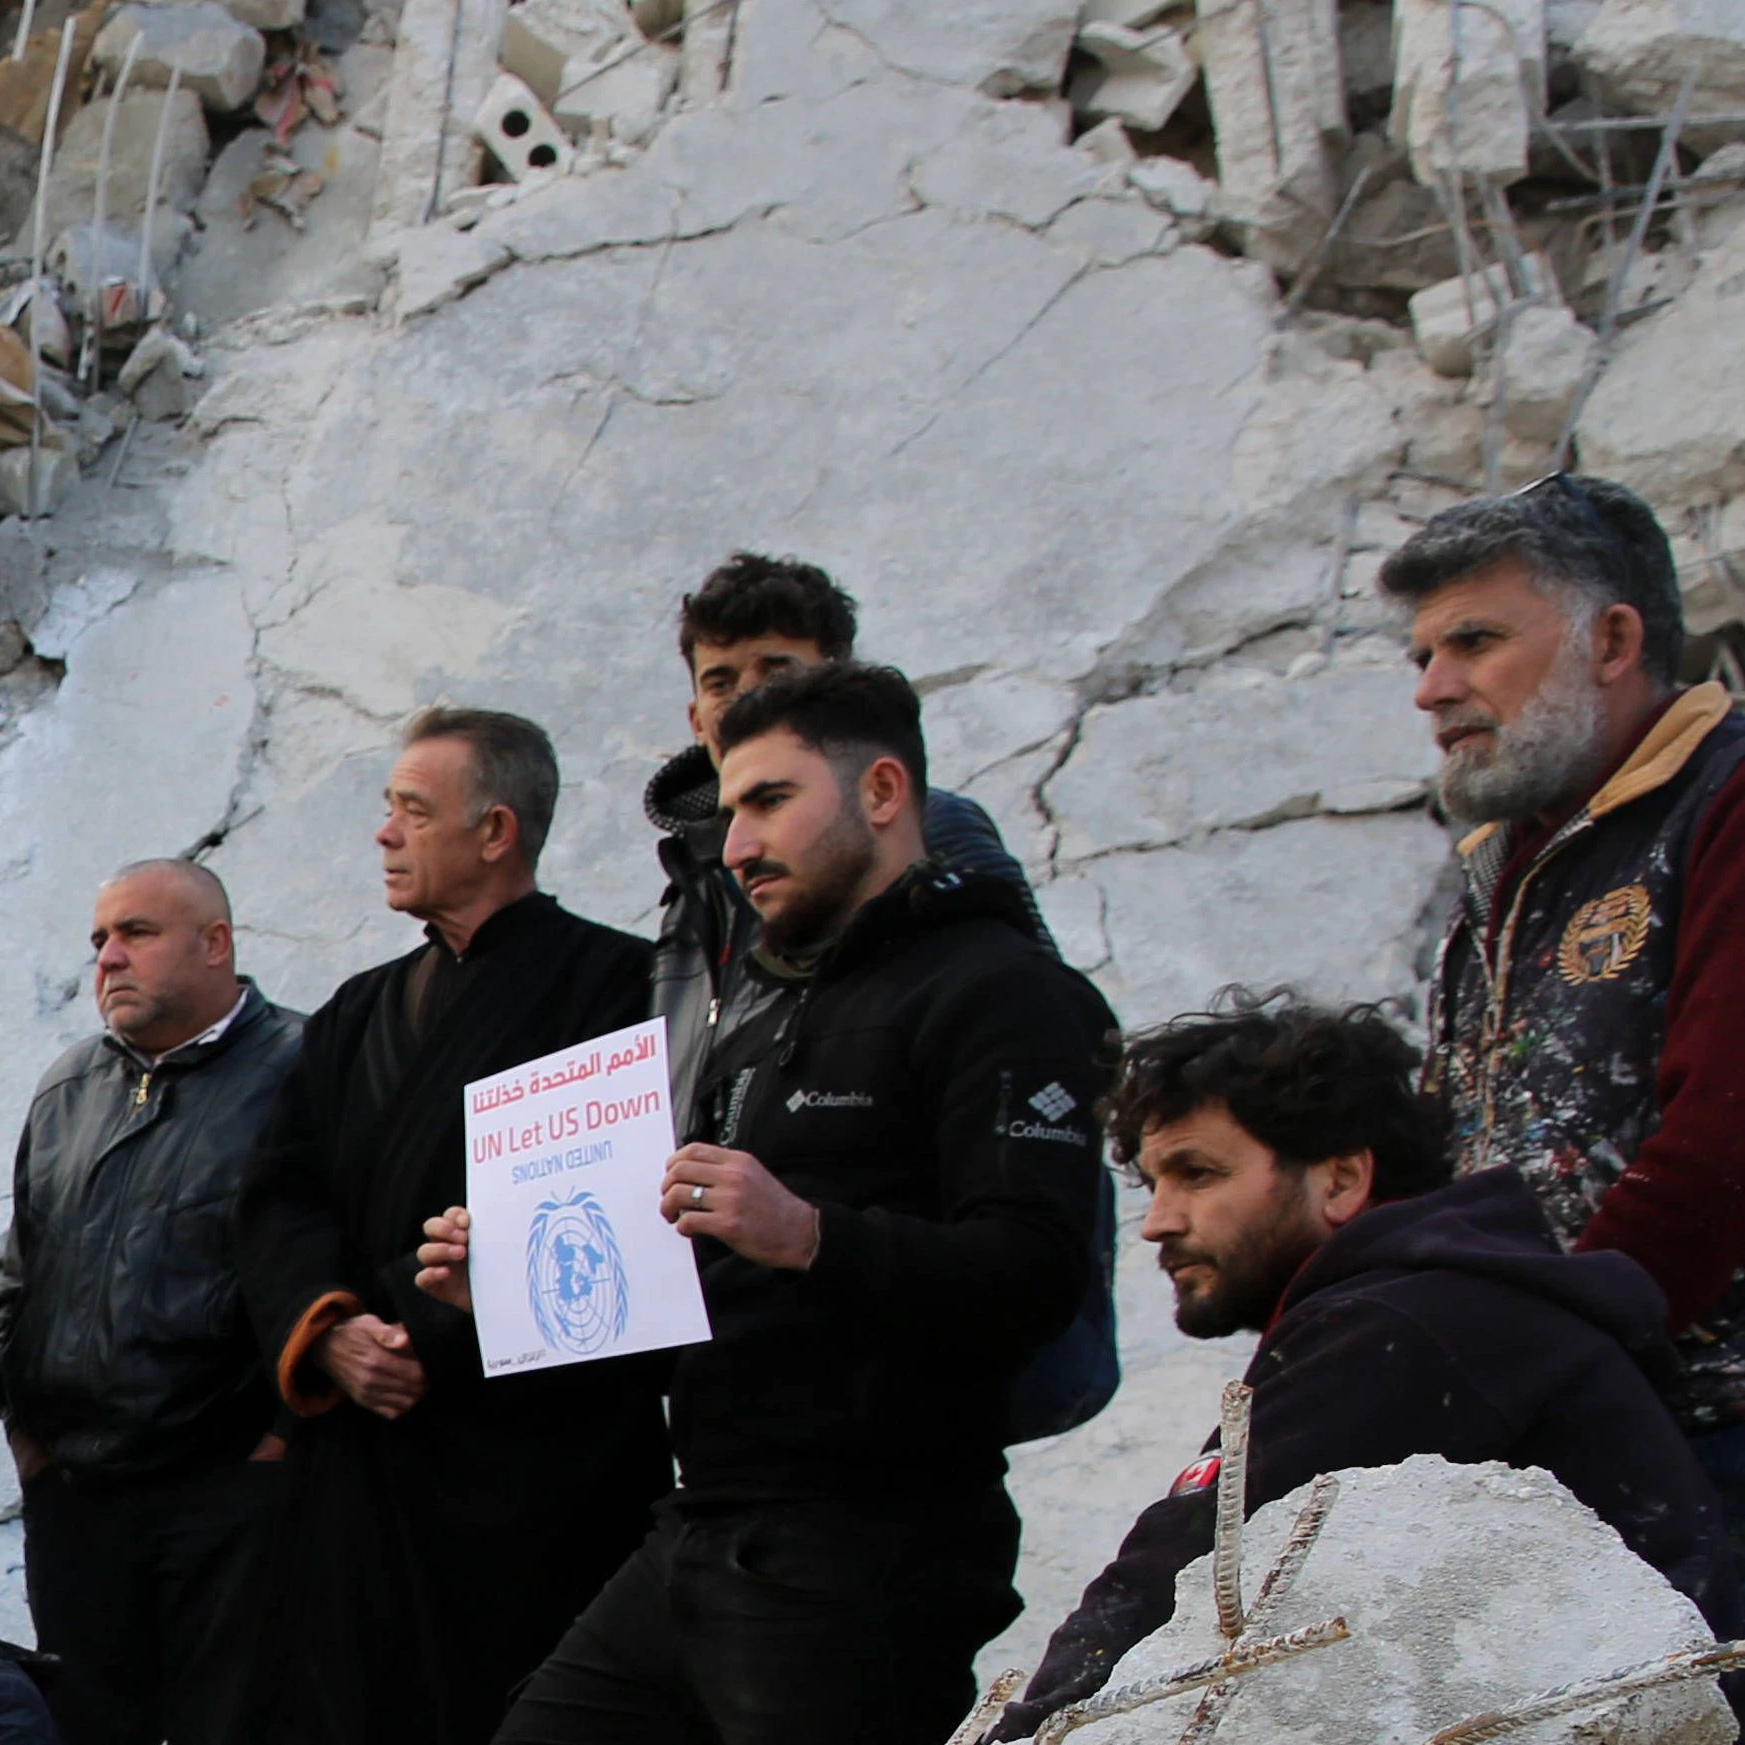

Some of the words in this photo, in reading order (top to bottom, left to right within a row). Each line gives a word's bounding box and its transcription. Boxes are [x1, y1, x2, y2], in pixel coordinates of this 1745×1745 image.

[473, 1134, 503, 1164] UN
[509, 1122, 544, 1151] Let
[548, 1108, 579, 1139] US
[587, 1090, 660, 1130] Down
